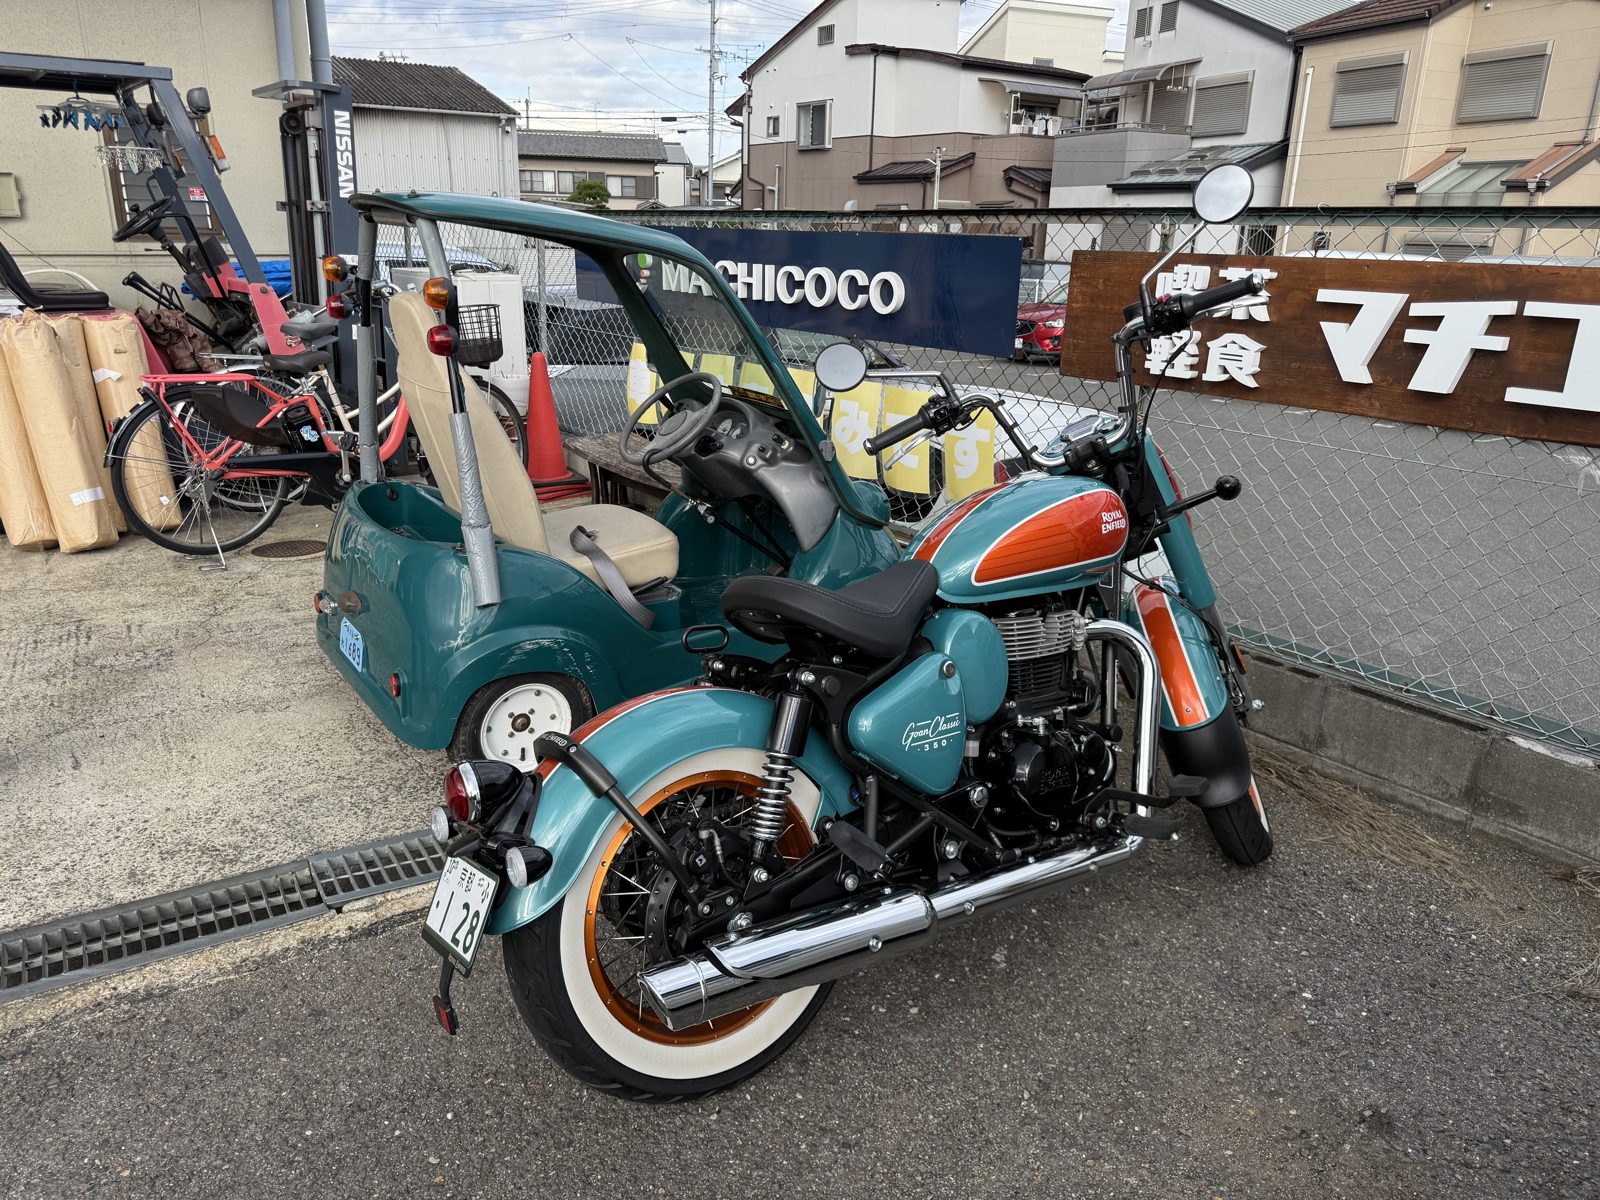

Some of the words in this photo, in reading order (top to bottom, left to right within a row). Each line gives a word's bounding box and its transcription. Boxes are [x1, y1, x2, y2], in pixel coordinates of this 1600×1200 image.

[333, 110, 356, 199] NISSAN
[661, 257, 905, 315] MACHICOCO
[1144, 330, 1267, 389] 軽食
[1101, 510, 1123, 522] ROYAL
[1101, 518, 1126, 534] ENFIELD
[902, 722, 929, 752] Goan
[928, 715, 961, 738] Classic
